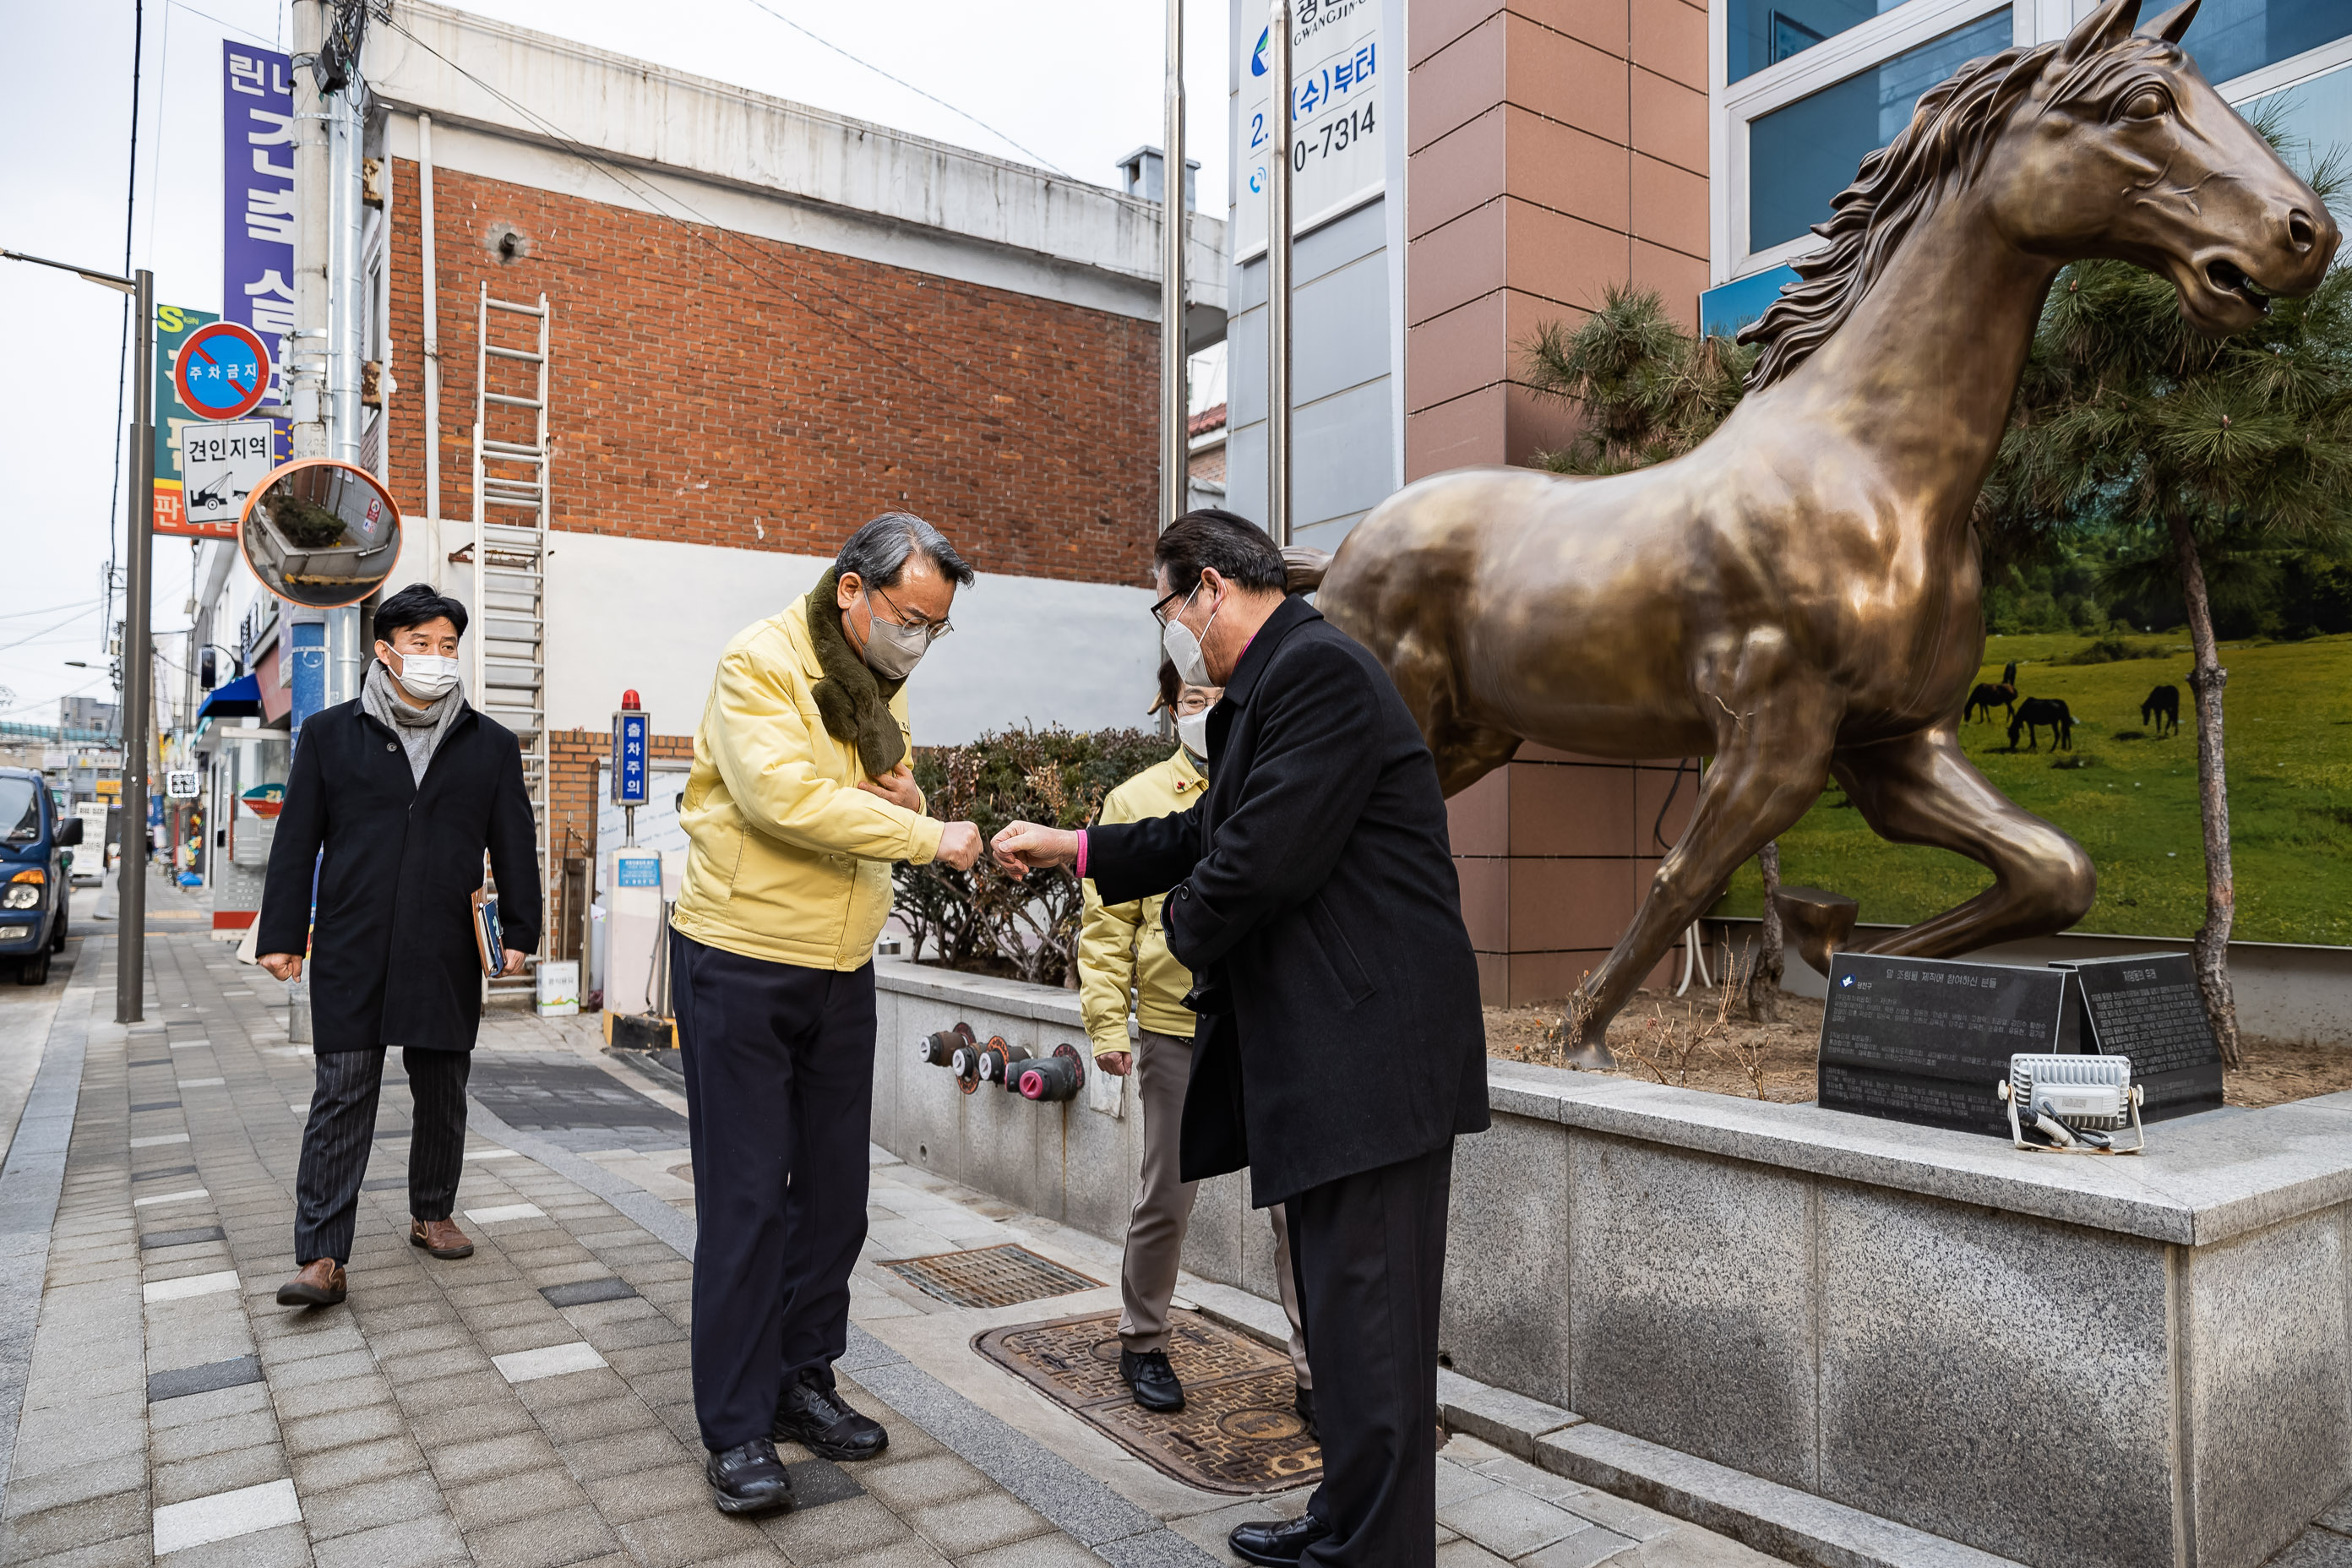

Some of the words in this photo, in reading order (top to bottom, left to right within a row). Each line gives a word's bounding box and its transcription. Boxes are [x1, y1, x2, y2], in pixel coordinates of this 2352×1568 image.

[189, 362, 258, 381] 주차금지
[188, 435, 266, 463] 견인지역
[626, 722, 641, 795] 출차주의
